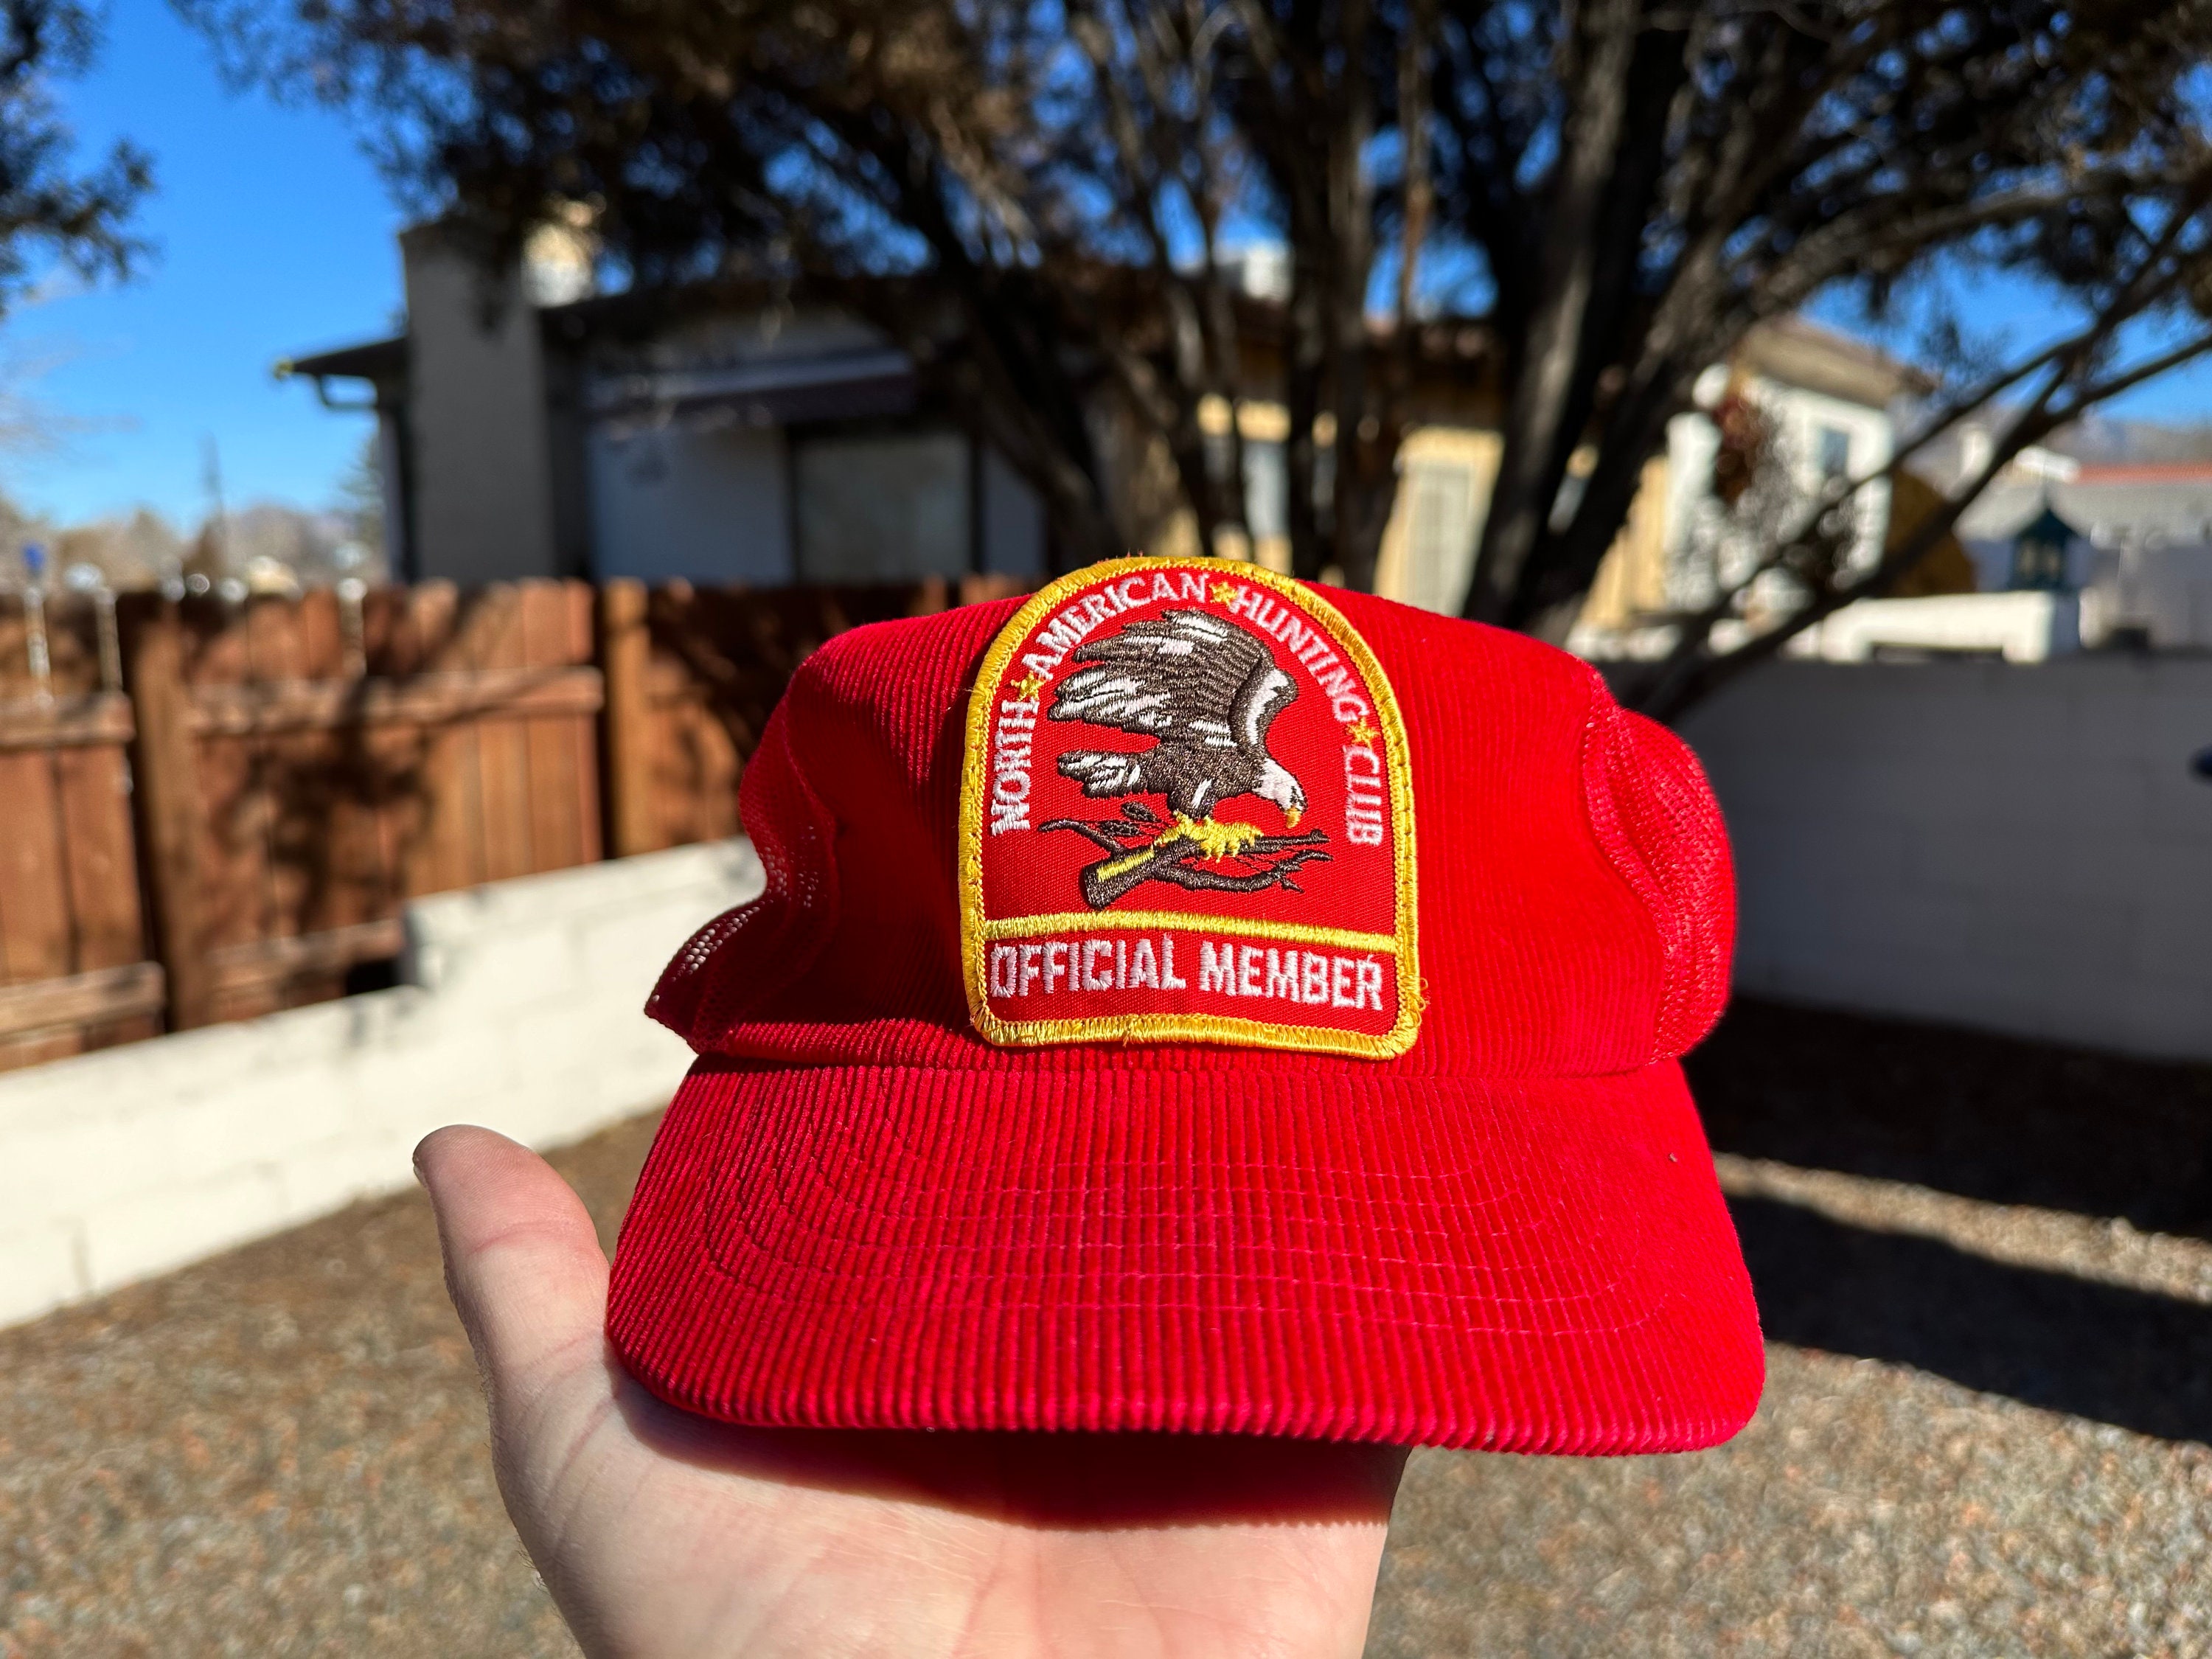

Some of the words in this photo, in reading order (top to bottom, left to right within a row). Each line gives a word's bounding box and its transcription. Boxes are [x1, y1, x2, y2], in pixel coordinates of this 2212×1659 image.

[991, 698, 1039, 836] NORTH
[1022, 572, 1210, 681] AMERICAN
[1230, 585, 1369, 723] HUNTING
[1342, 745, 1384, 846] CLUB
[990, 935, 1186, 998] OFFICIAL
[1200, 941, 1383, 1011] MEMBER
